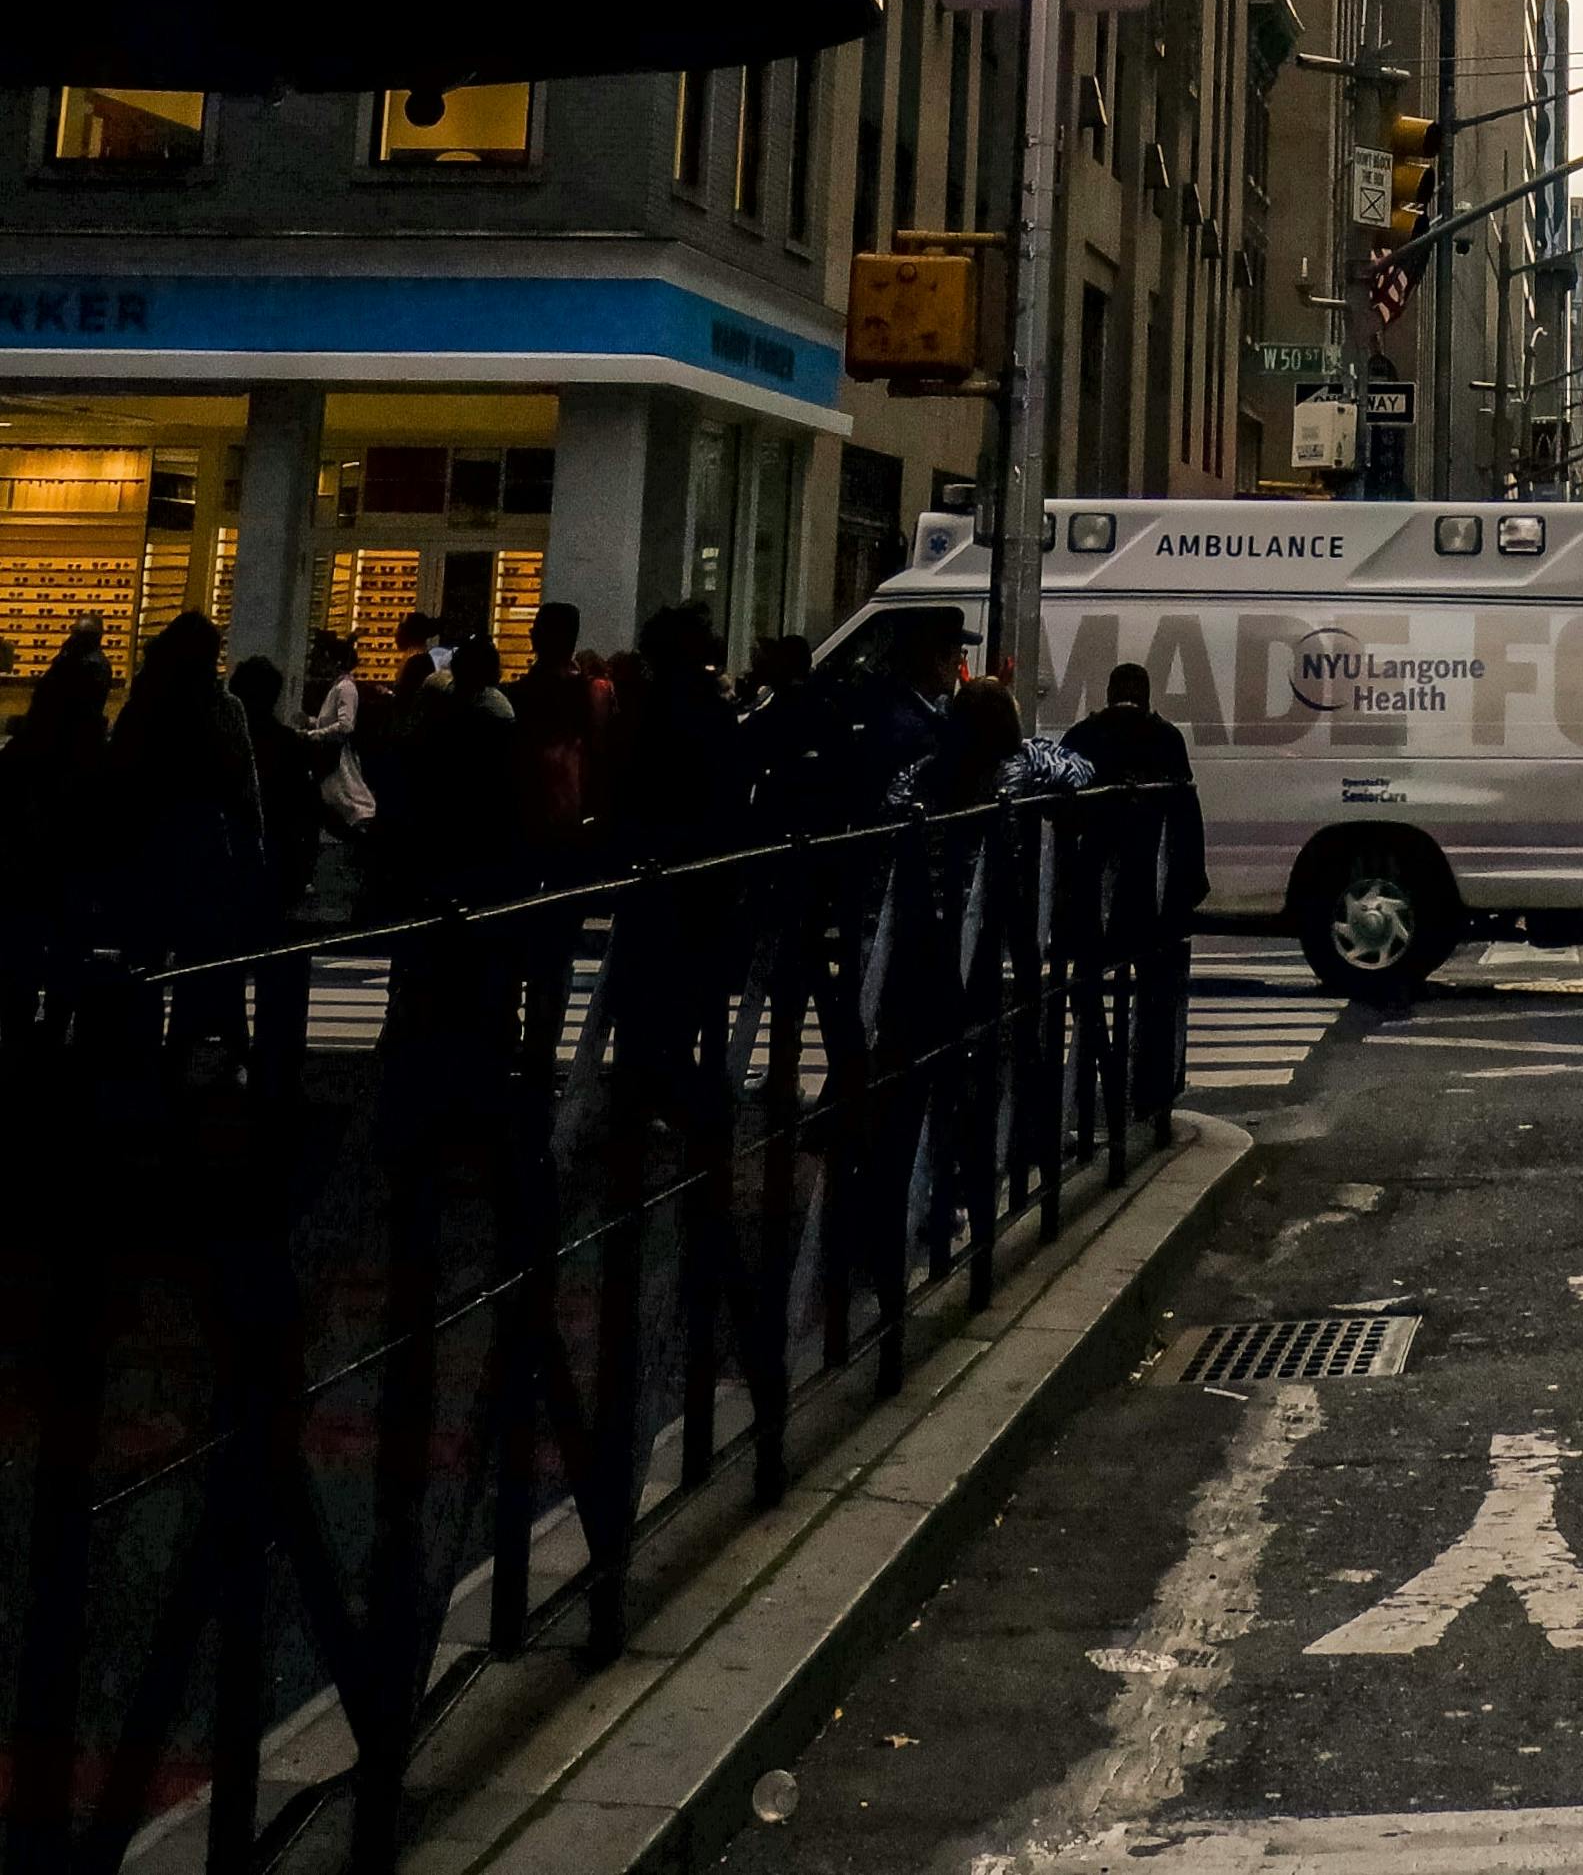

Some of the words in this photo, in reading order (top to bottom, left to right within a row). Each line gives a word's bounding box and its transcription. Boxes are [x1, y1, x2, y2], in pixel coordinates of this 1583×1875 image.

[1264, 348, 1276, 370] W
[1281, 348, 1301, 371] 50
[1155, 534, 1344, 559] AMBULANCE
[1038, 613, 1409, 747] MADE
[1303, 653, 1362, 680] NYU
[1366, 653, 1485, 685] Langone
[1353, 685, 1446, 712] Health
